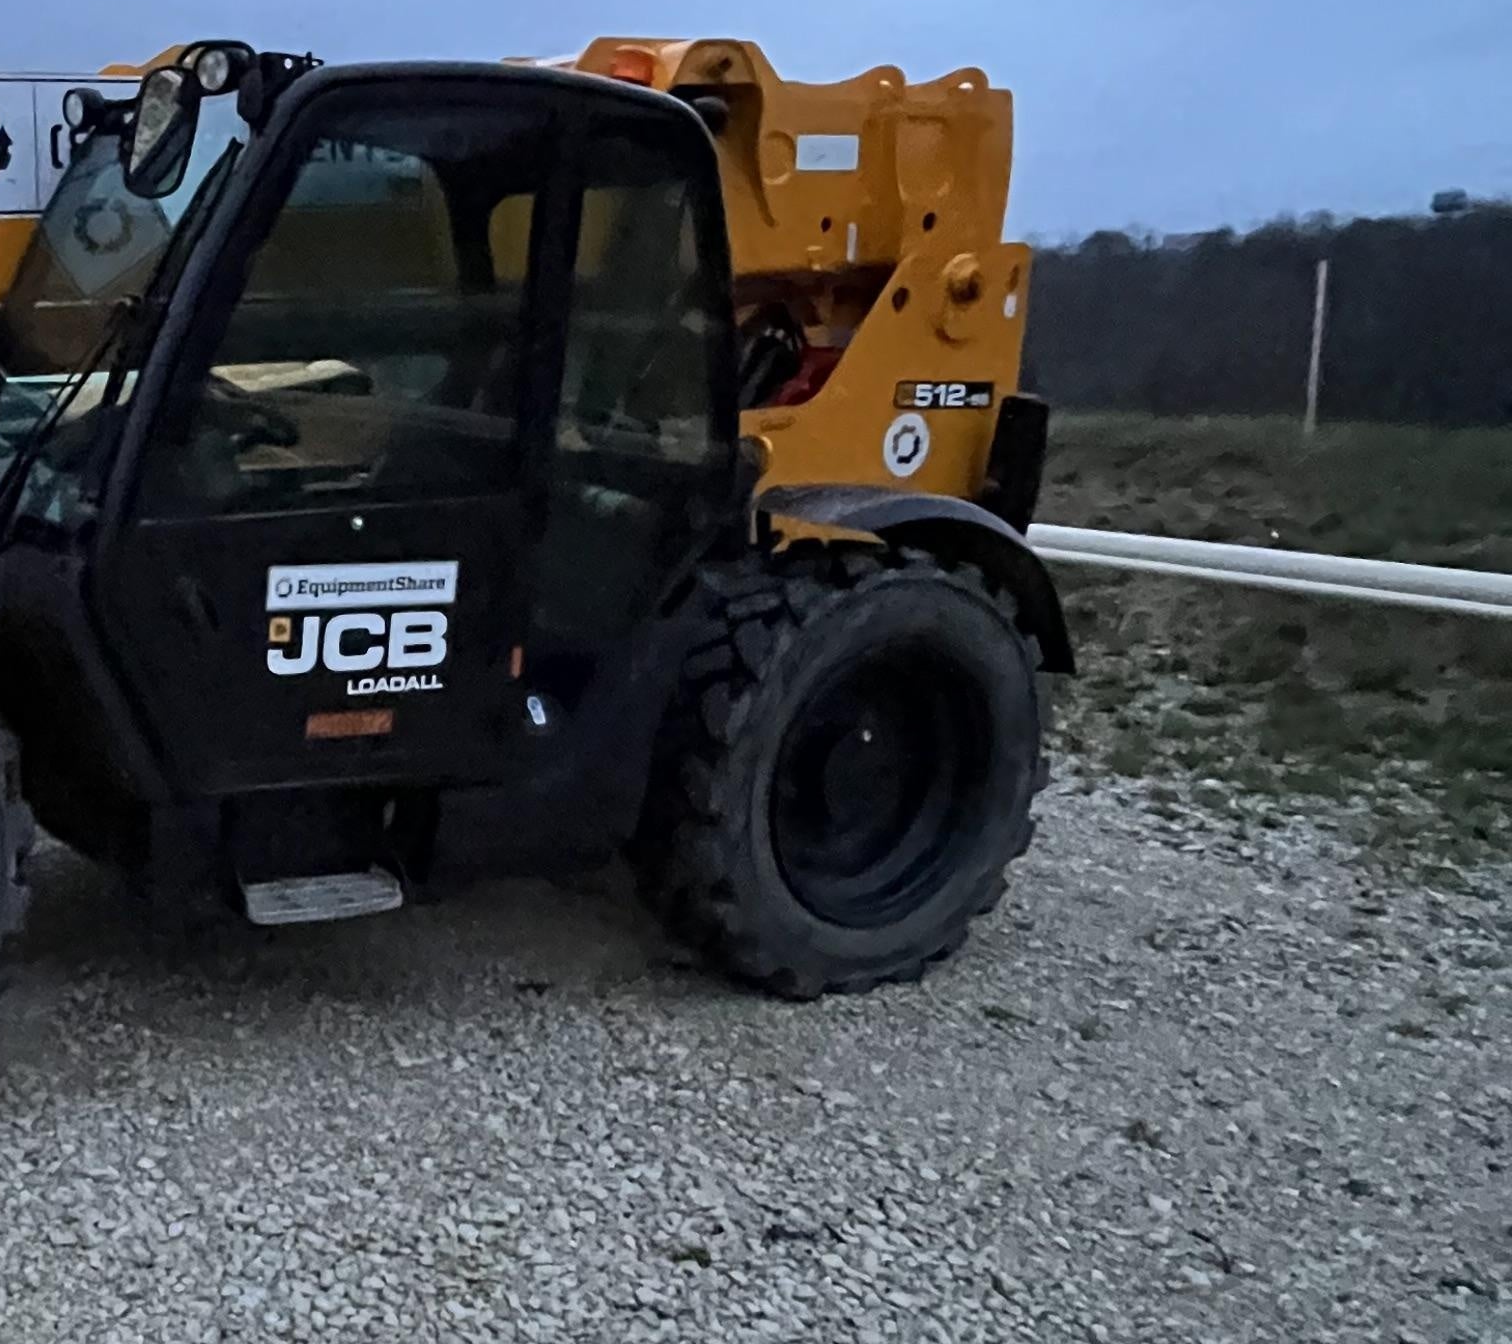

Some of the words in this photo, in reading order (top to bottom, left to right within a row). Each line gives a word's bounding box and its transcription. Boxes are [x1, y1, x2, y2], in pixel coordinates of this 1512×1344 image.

[296, 576, 446, 597] EquipmentShare
[267, 611, 448, 675] JCB
[346, 674, 444, 695] LOADALL
